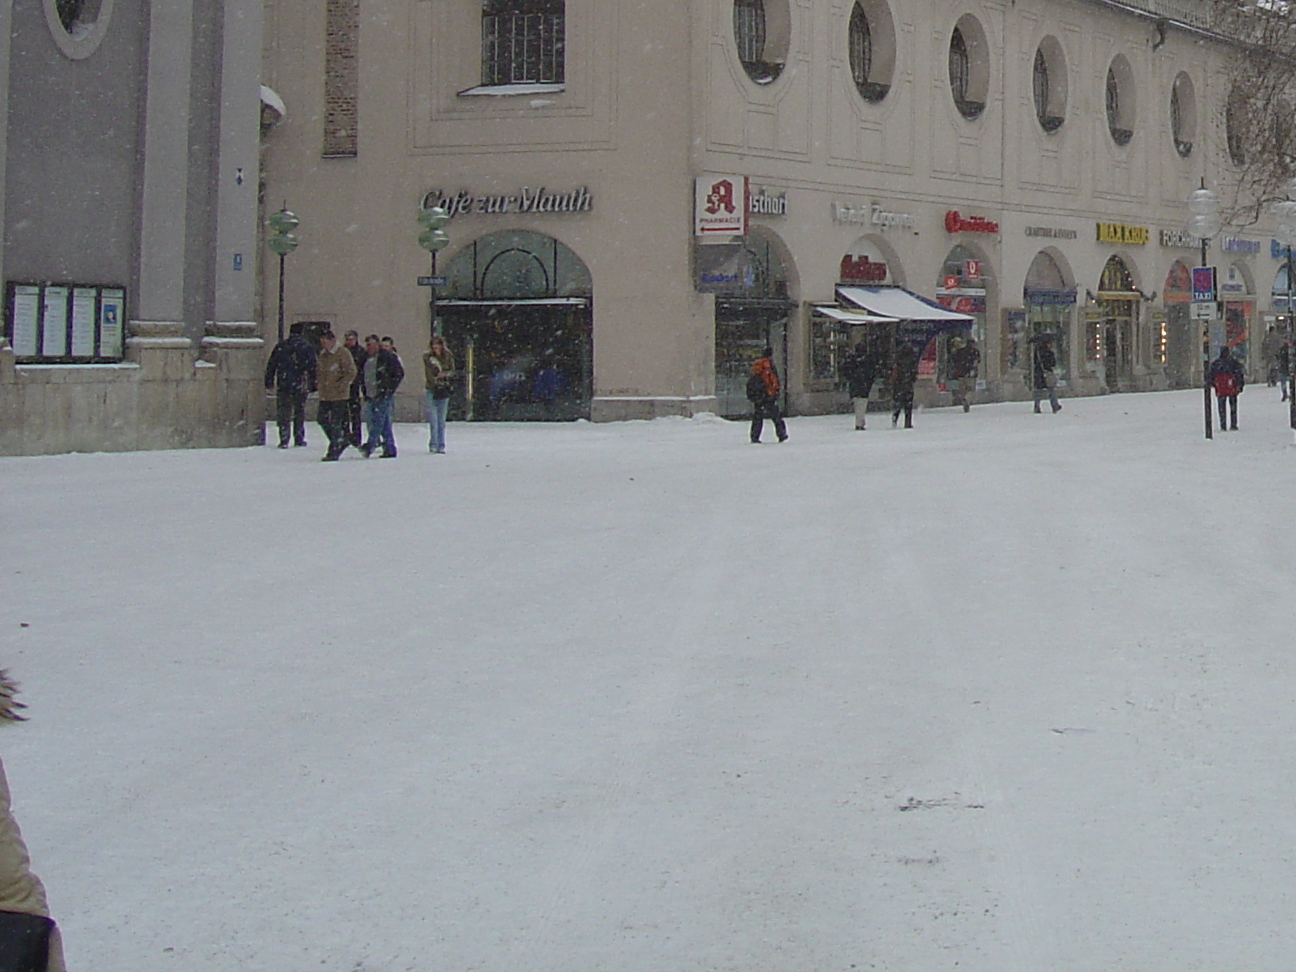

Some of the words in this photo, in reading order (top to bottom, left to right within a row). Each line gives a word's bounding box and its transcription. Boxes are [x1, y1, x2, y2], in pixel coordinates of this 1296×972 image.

[476, 194, 515, 214] zur
[516, 185, 593, 213] Mauth
[1096, 222, 1120, 242] MAX
[1193, 292, 1212, 301] TAXI
